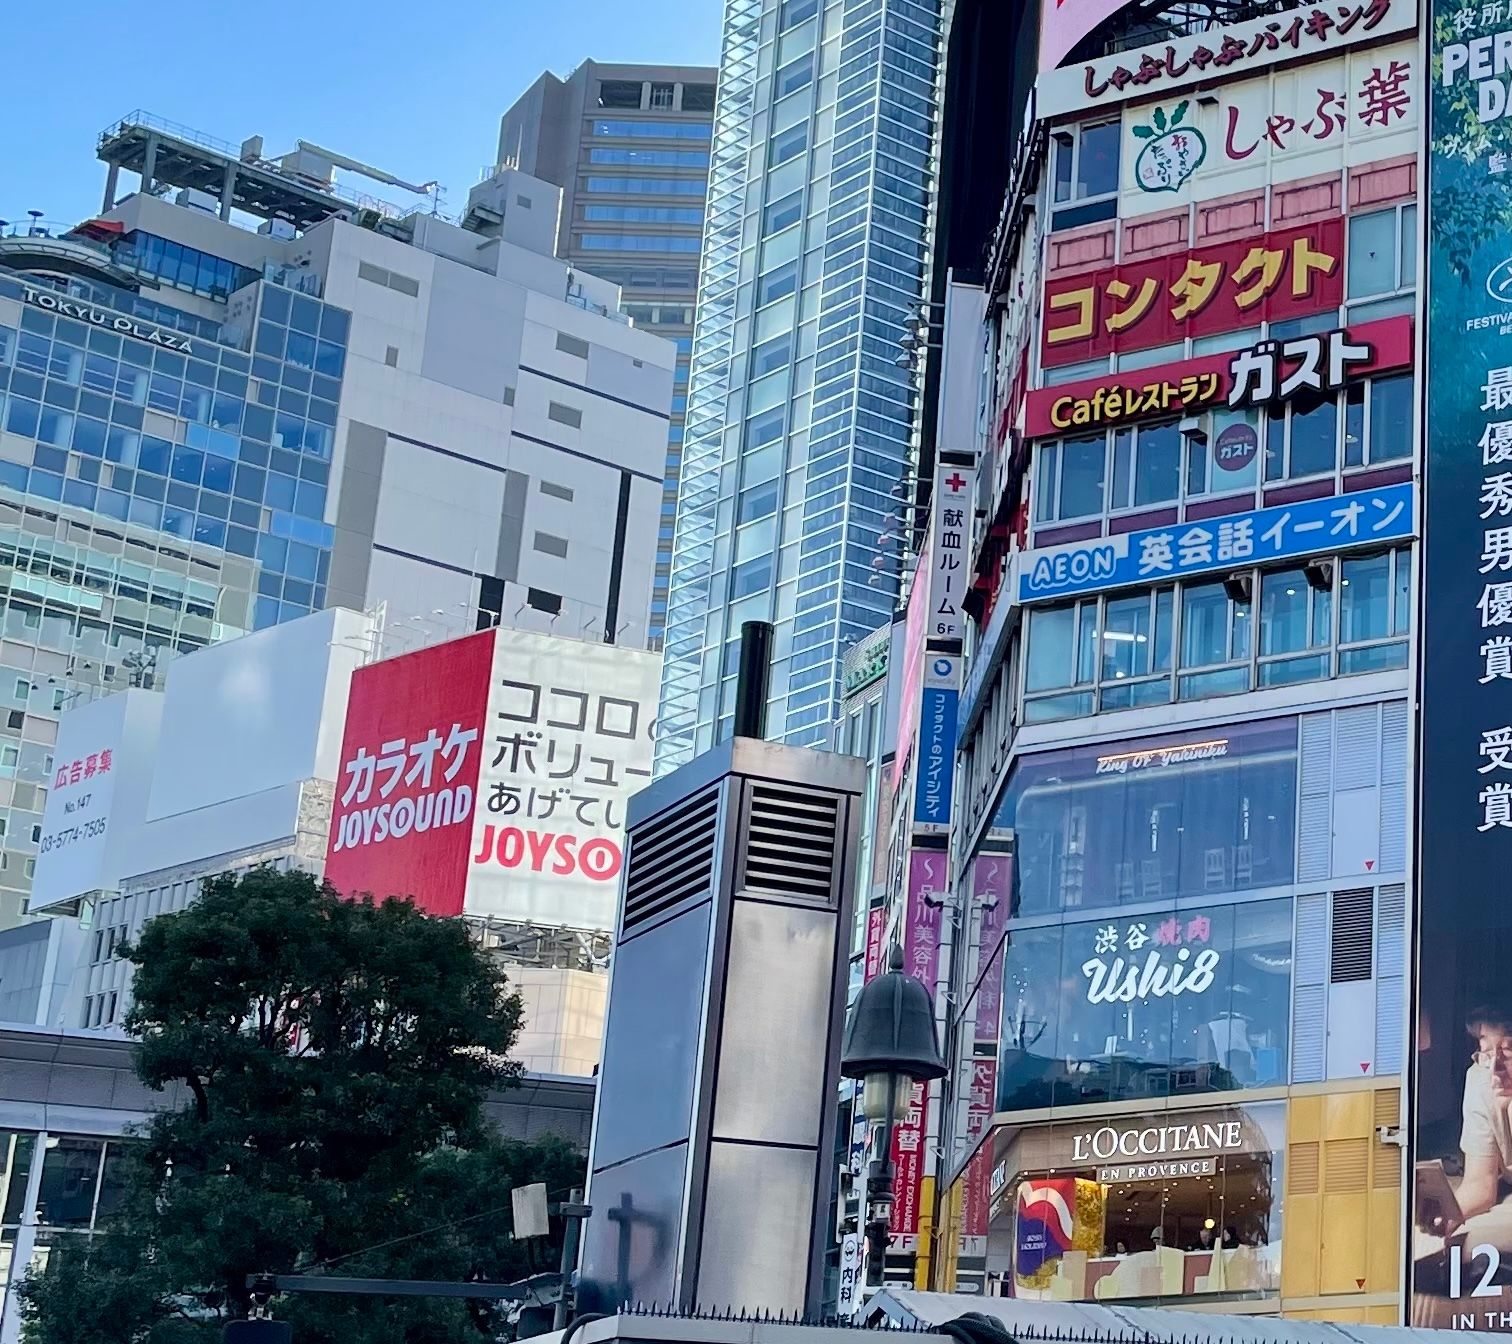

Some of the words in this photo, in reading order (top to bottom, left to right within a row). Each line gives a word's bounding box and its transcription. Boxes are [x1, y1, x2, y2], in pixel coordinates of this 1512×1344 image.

[1225, 60, 1412, 160] しゃぶ葉
[1046, 237, 1337, 343] コンタクト
[22, 288, 106, 328] TOKYU
[112, 316, 194, 355] PLAZA
[1229, 333, 1370, 409] ガスト
[1220, 442, 1254, 459] ガスト
[937, 508, 964, 616] 献血ルーム
[1031, 549, 1116, 585] AEON
[1138, 499, 1405, 576] 英会話イーオン
[936, 622, 957, 635] 6F
[54, 748, 113, 791] 広告募集
[341, 723, 479, 808] カラオケ
[491, 730, 652, 787] ボリュー
[333, 784, 473, 853] JOYSOUND
[474, 824, 622, 881] JOYSO
[1094, 922, 1150, 955] 渋谷
[1081, 947, 1221, 1005] Ushi8
[1071, 1120, 1243, 1161] L'OCCITANE
[1128, 1161, 1211, 1179] PROVENCE
[1452, 1313, 1476, 1330] IN
